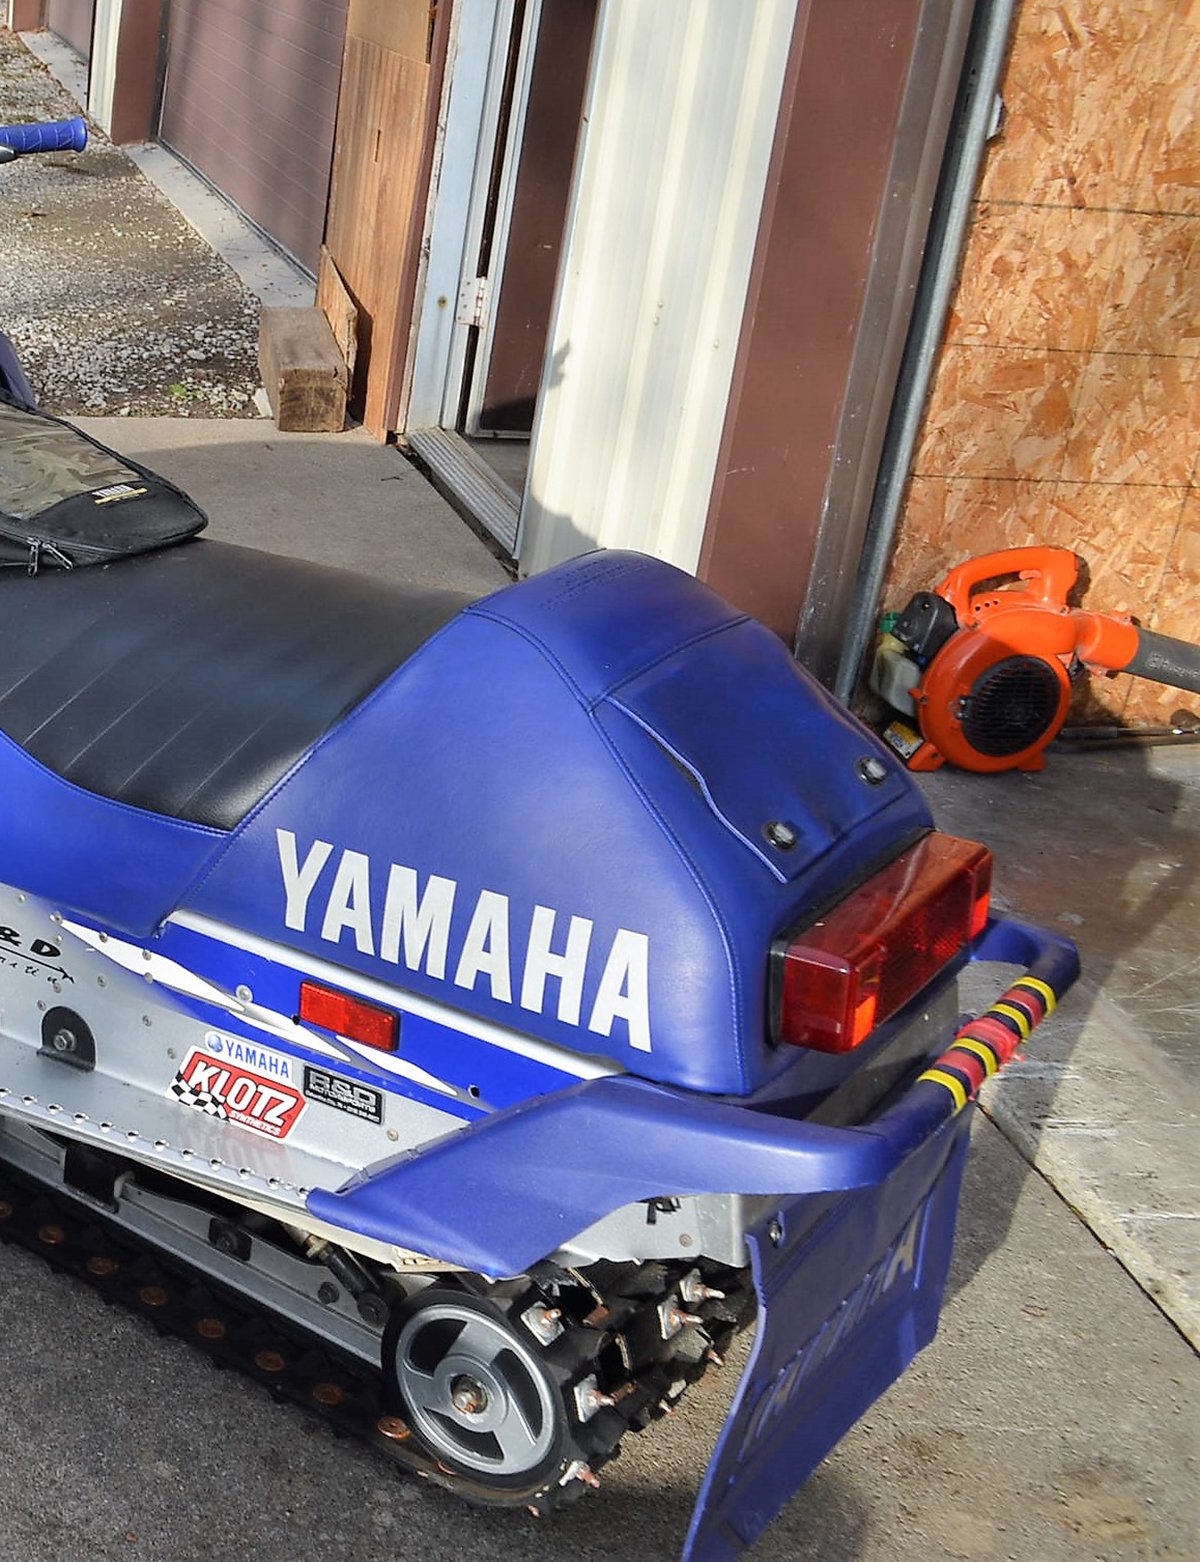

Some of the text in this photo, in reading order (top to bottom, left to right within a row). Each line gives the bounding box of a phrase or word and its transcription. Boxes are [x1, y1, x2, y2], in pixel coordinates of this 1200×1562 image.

[275, 827, 653, 1054] YAMAHA
[187, 1059, 299, 1129] KLOTZ
[225, 1039, 290, 1079] YAMAHA
